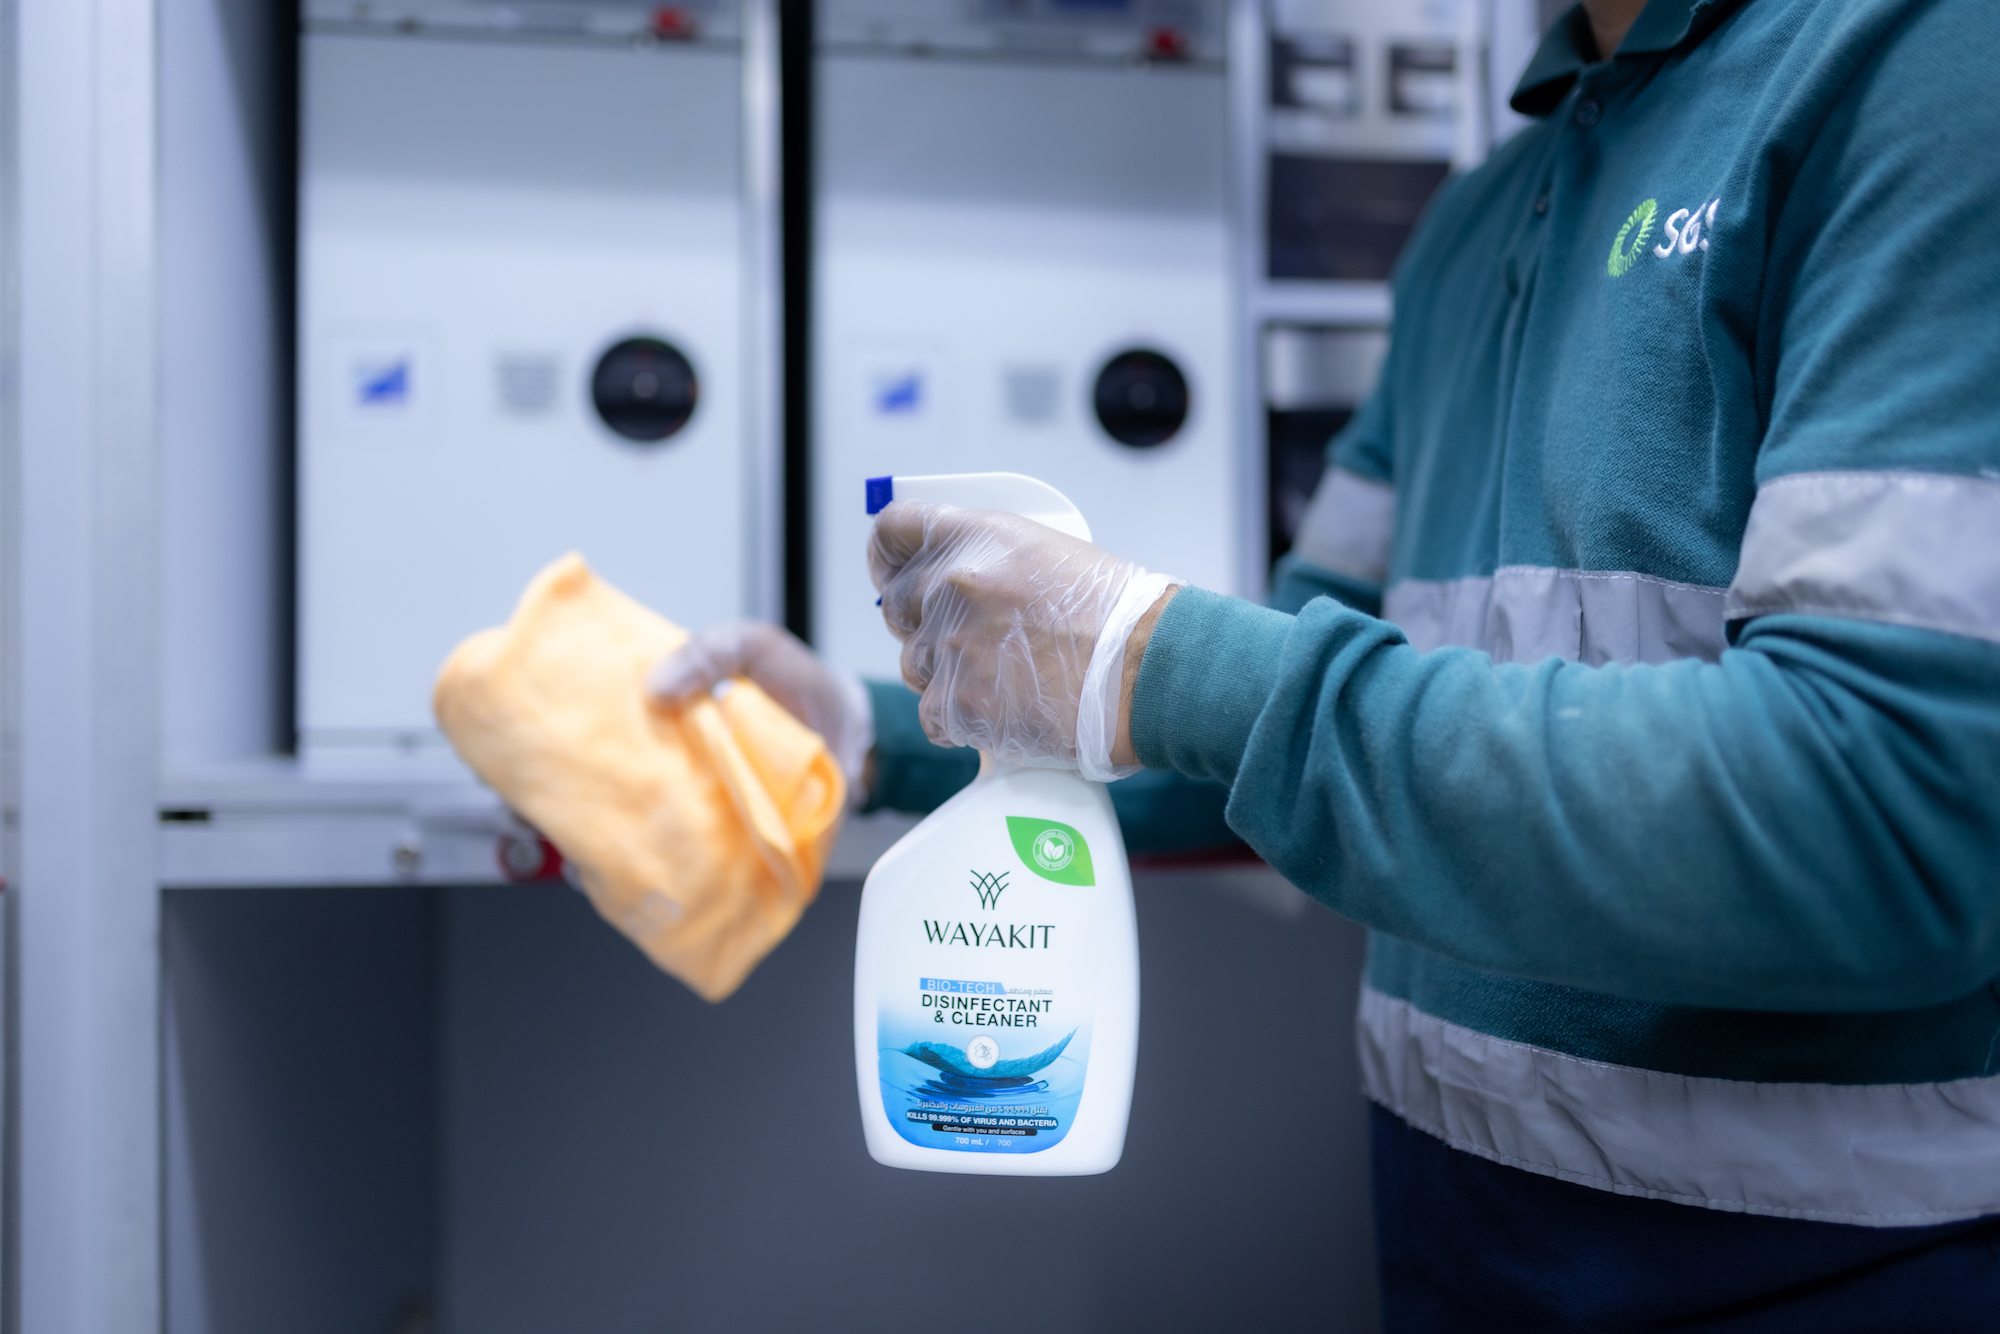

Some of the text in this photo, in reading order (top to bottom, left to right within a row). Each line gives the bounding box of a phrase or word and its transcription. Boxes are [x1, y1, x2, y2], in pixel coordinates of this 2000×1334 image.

[923, 919, 1056, 949] WAYAKIT
[926, 979, 996, 994] BIO-TECH
[922, 993, 1053, 1013] DISINFECTANT
[934, 1010, 1037, 1028] & CLEANER
[906, 1111, 1057, 1127] KILLS 99.999% OF VIRUS AND BACTERIA
[1000, 1128, 1026, 1136] surfaces
[955, 1136, 969, 1145] 700
[970, 1138, 984, 1146] mL
[997, 1139, 1012, 1147] 700
